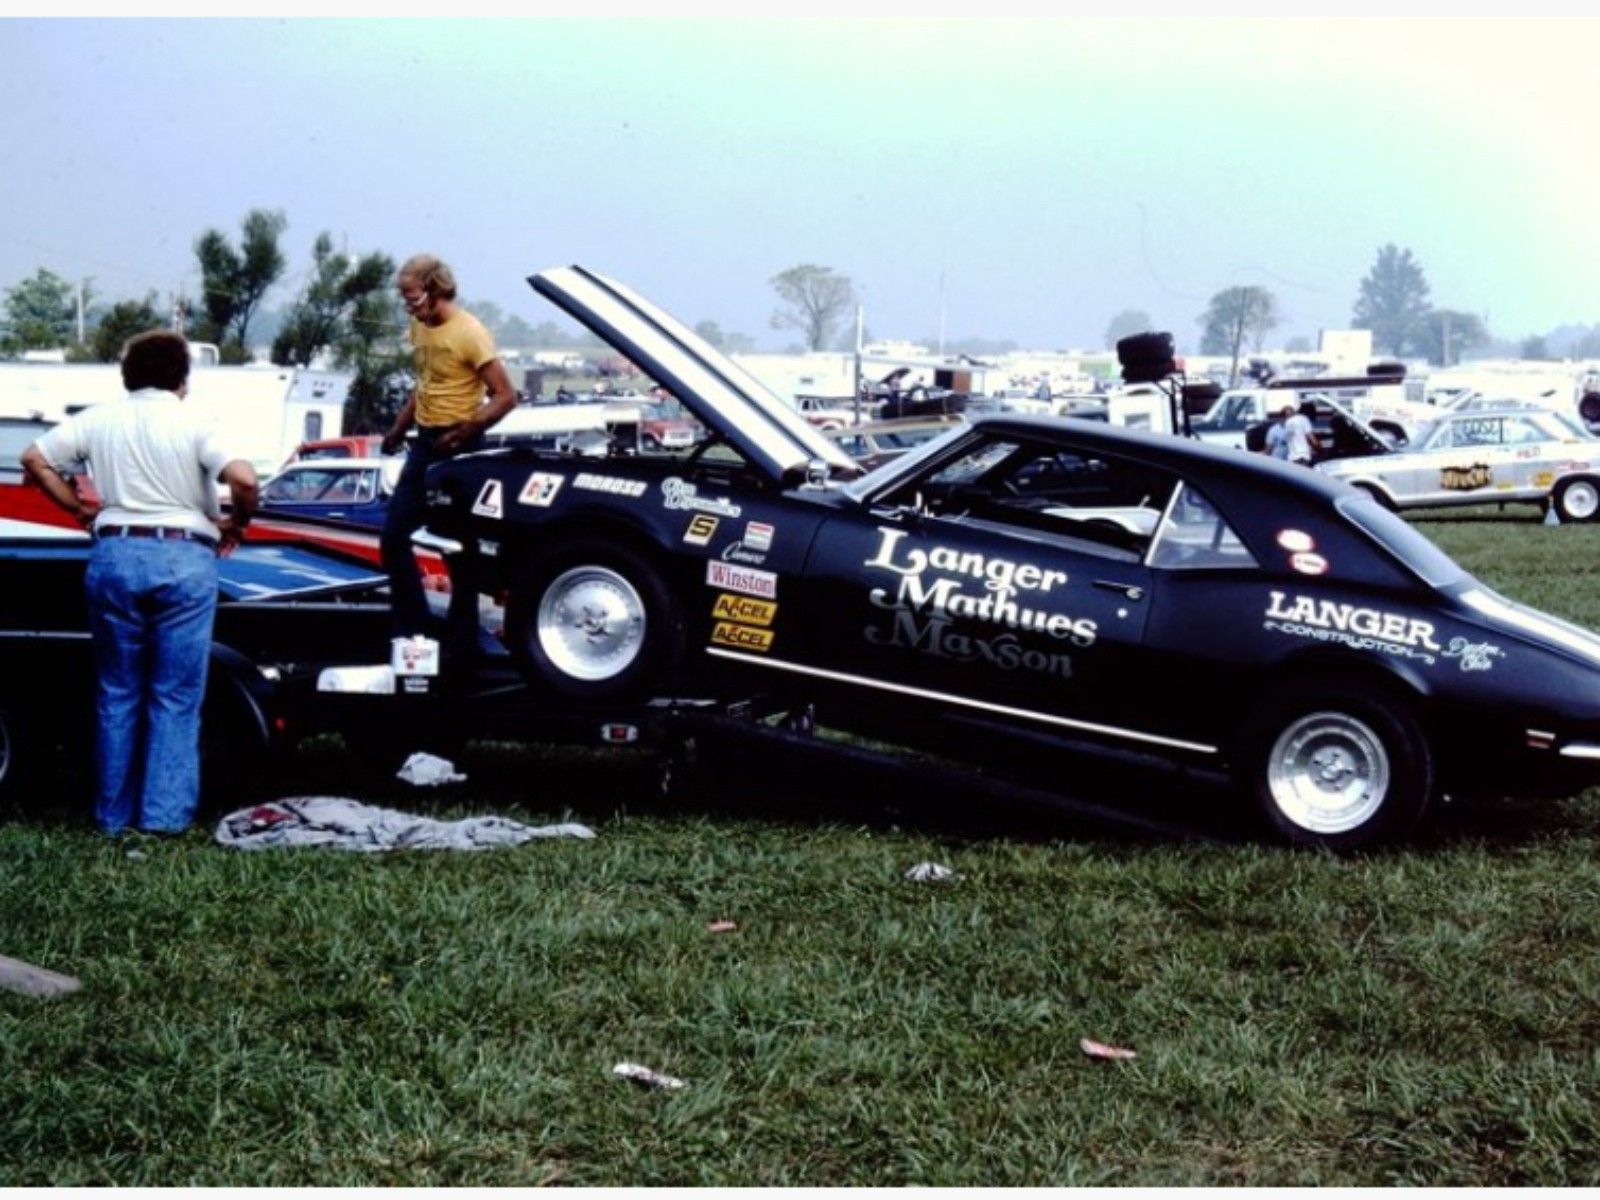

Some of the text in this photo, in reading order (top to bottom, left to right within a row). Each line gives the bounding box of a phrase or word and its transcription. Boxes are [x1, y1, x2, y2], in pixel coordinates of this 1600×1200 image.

[711, 563, 774, 595] Winston
[863, 525, 1068, 592] Langer
[715, 597, 772, 621] ACCEL
[868, 574, 1098, 647] Mathues
[1264, 590, 1441, 651] LANGER
[715, 625, 770, 647] ACCEL
[862, 608, 1074, 679] Maxson
[1278, 621, 1418, 659] CONSTRUCTION
